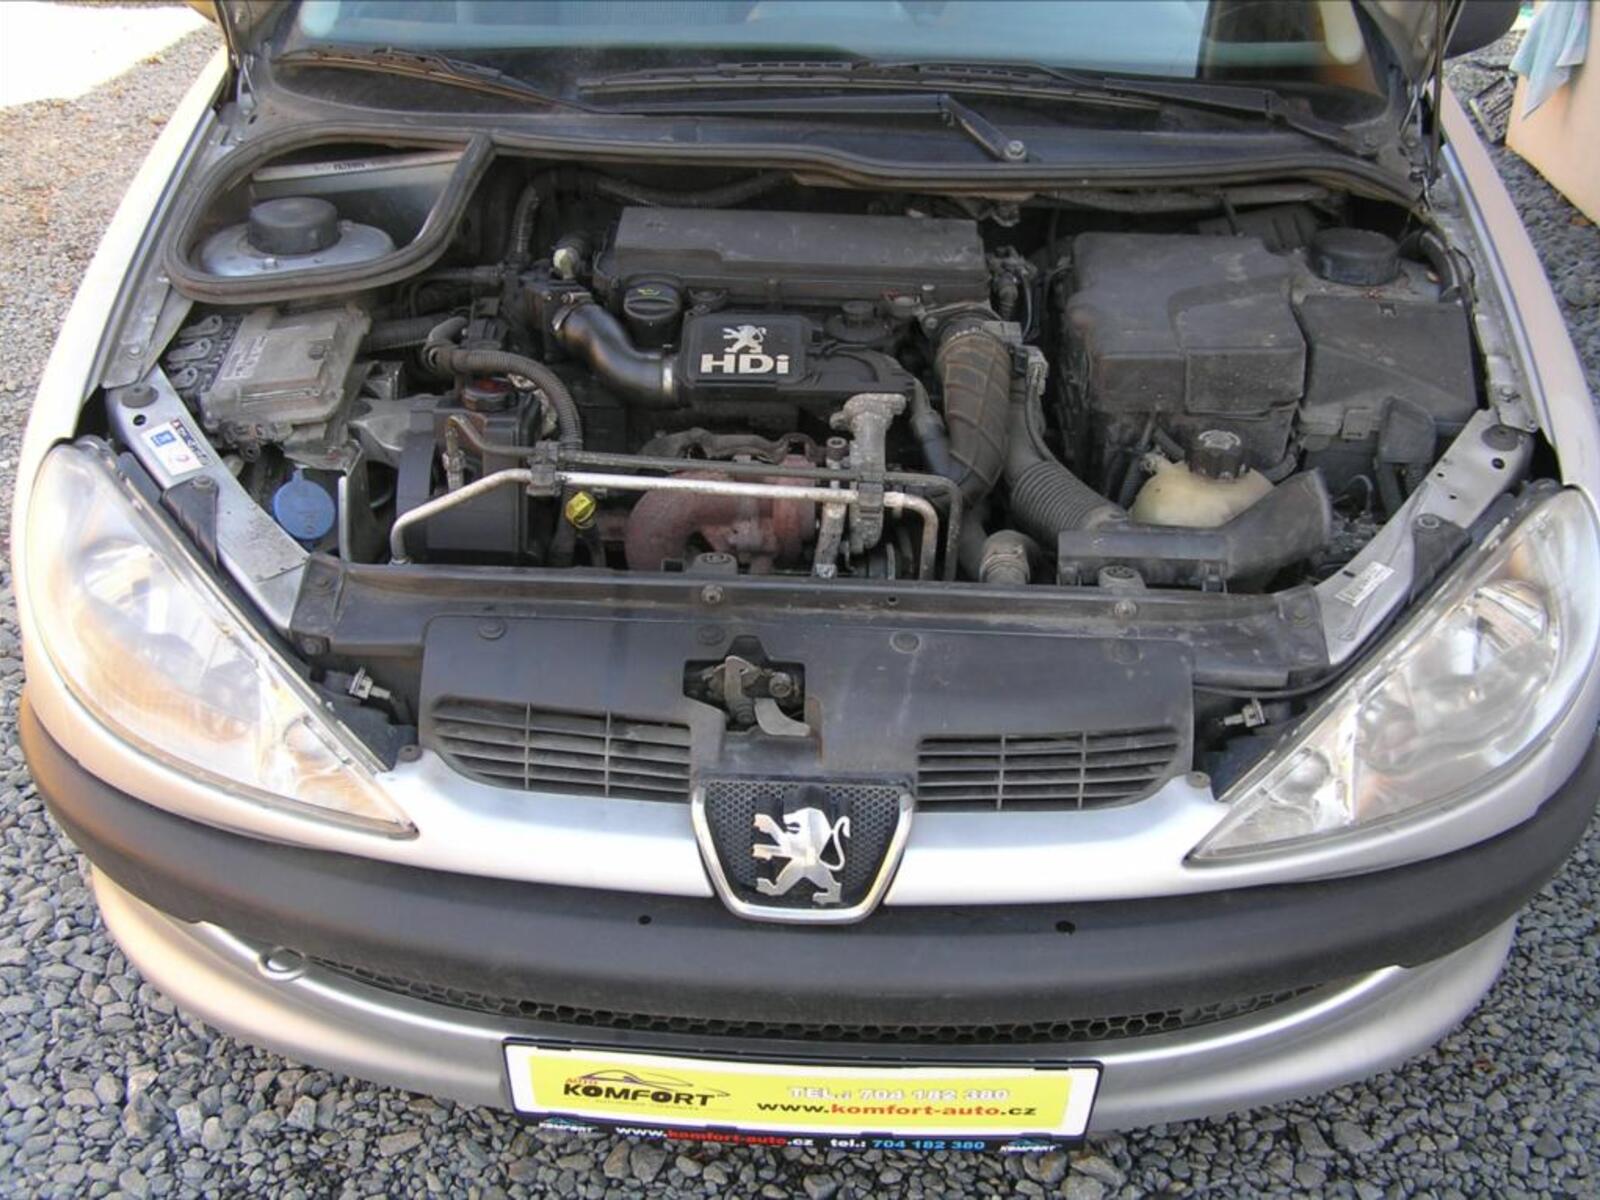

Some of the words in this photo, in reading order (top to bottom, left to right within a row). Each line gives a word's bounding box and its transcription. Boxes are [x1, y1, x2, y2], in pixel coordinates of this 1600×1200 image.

[700, 353, 790, 374] HDi
[563, 1083, 715, 1106] KOMFORT
[858, 1088, 905, 1101] 704
[912, 1088, 958, 1101] 182
[757, 1101, 1037, 1116] www.komfort-auto.cz
[616, 1127, 814, 1146] www.komfort-auto.cz
[871, 1138, 905, 1149] 704
[911, 1139, 945, 1150] 182
[951, 1139, 986, 1150] 380
